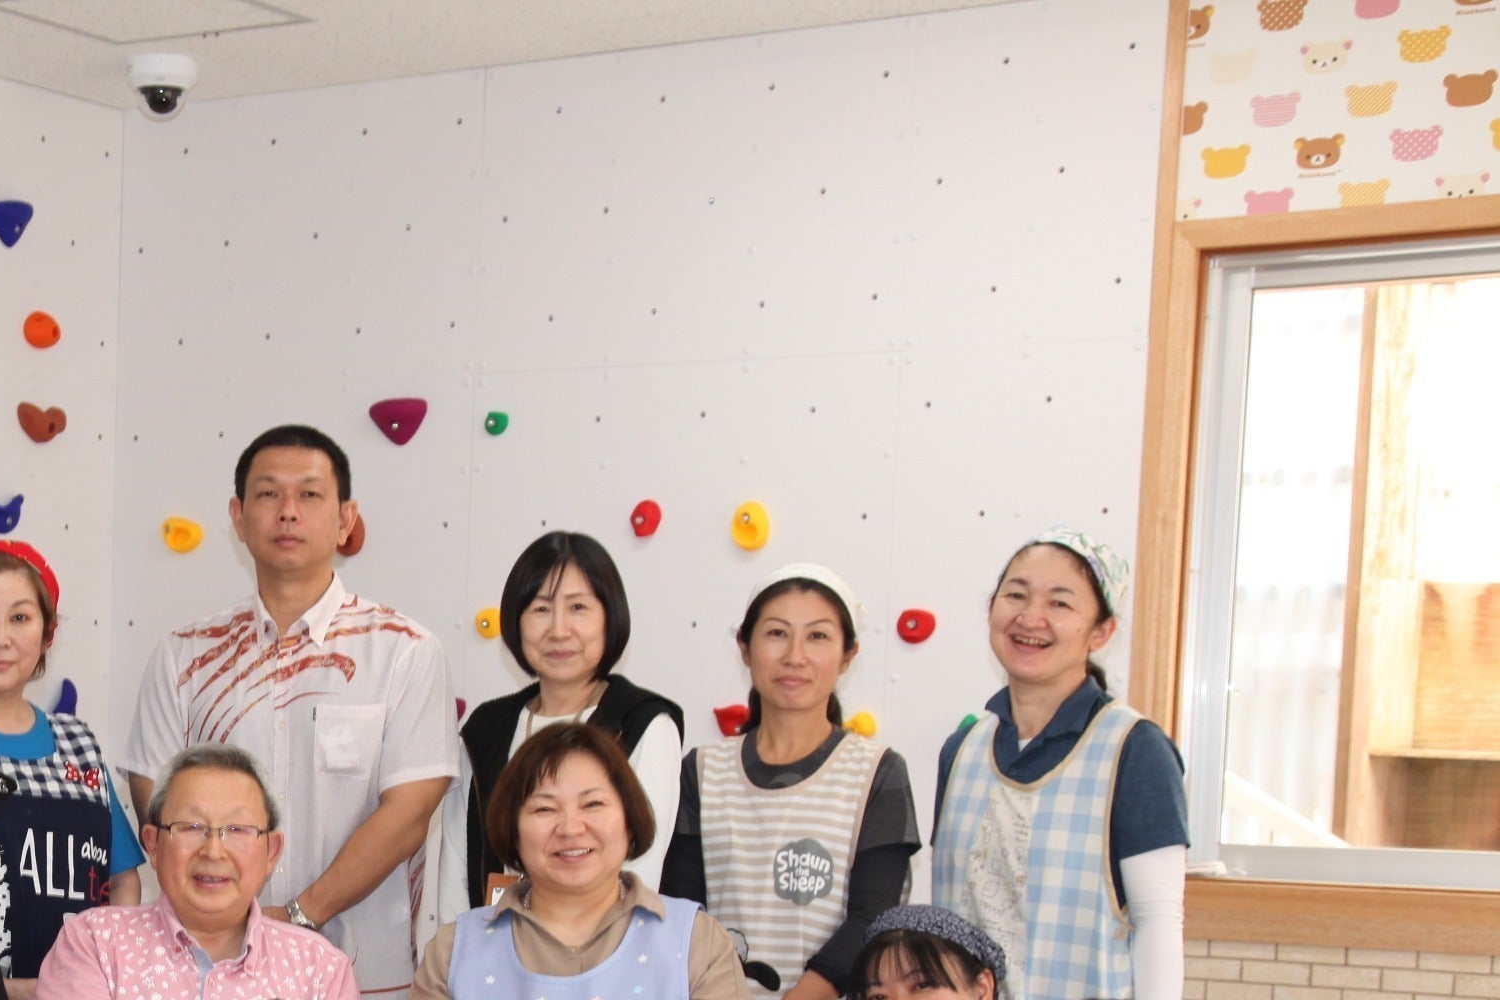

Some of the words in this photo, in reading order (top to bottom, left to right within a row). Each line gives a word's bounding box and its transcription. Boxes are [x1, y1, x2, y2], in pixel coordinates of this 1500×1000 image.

[20, 827, 84, 900] ALL
[777, 849, 831, 873] Shaun
[795, 866, 810, 877] the
[779, 872, 825, 896] Sheep
